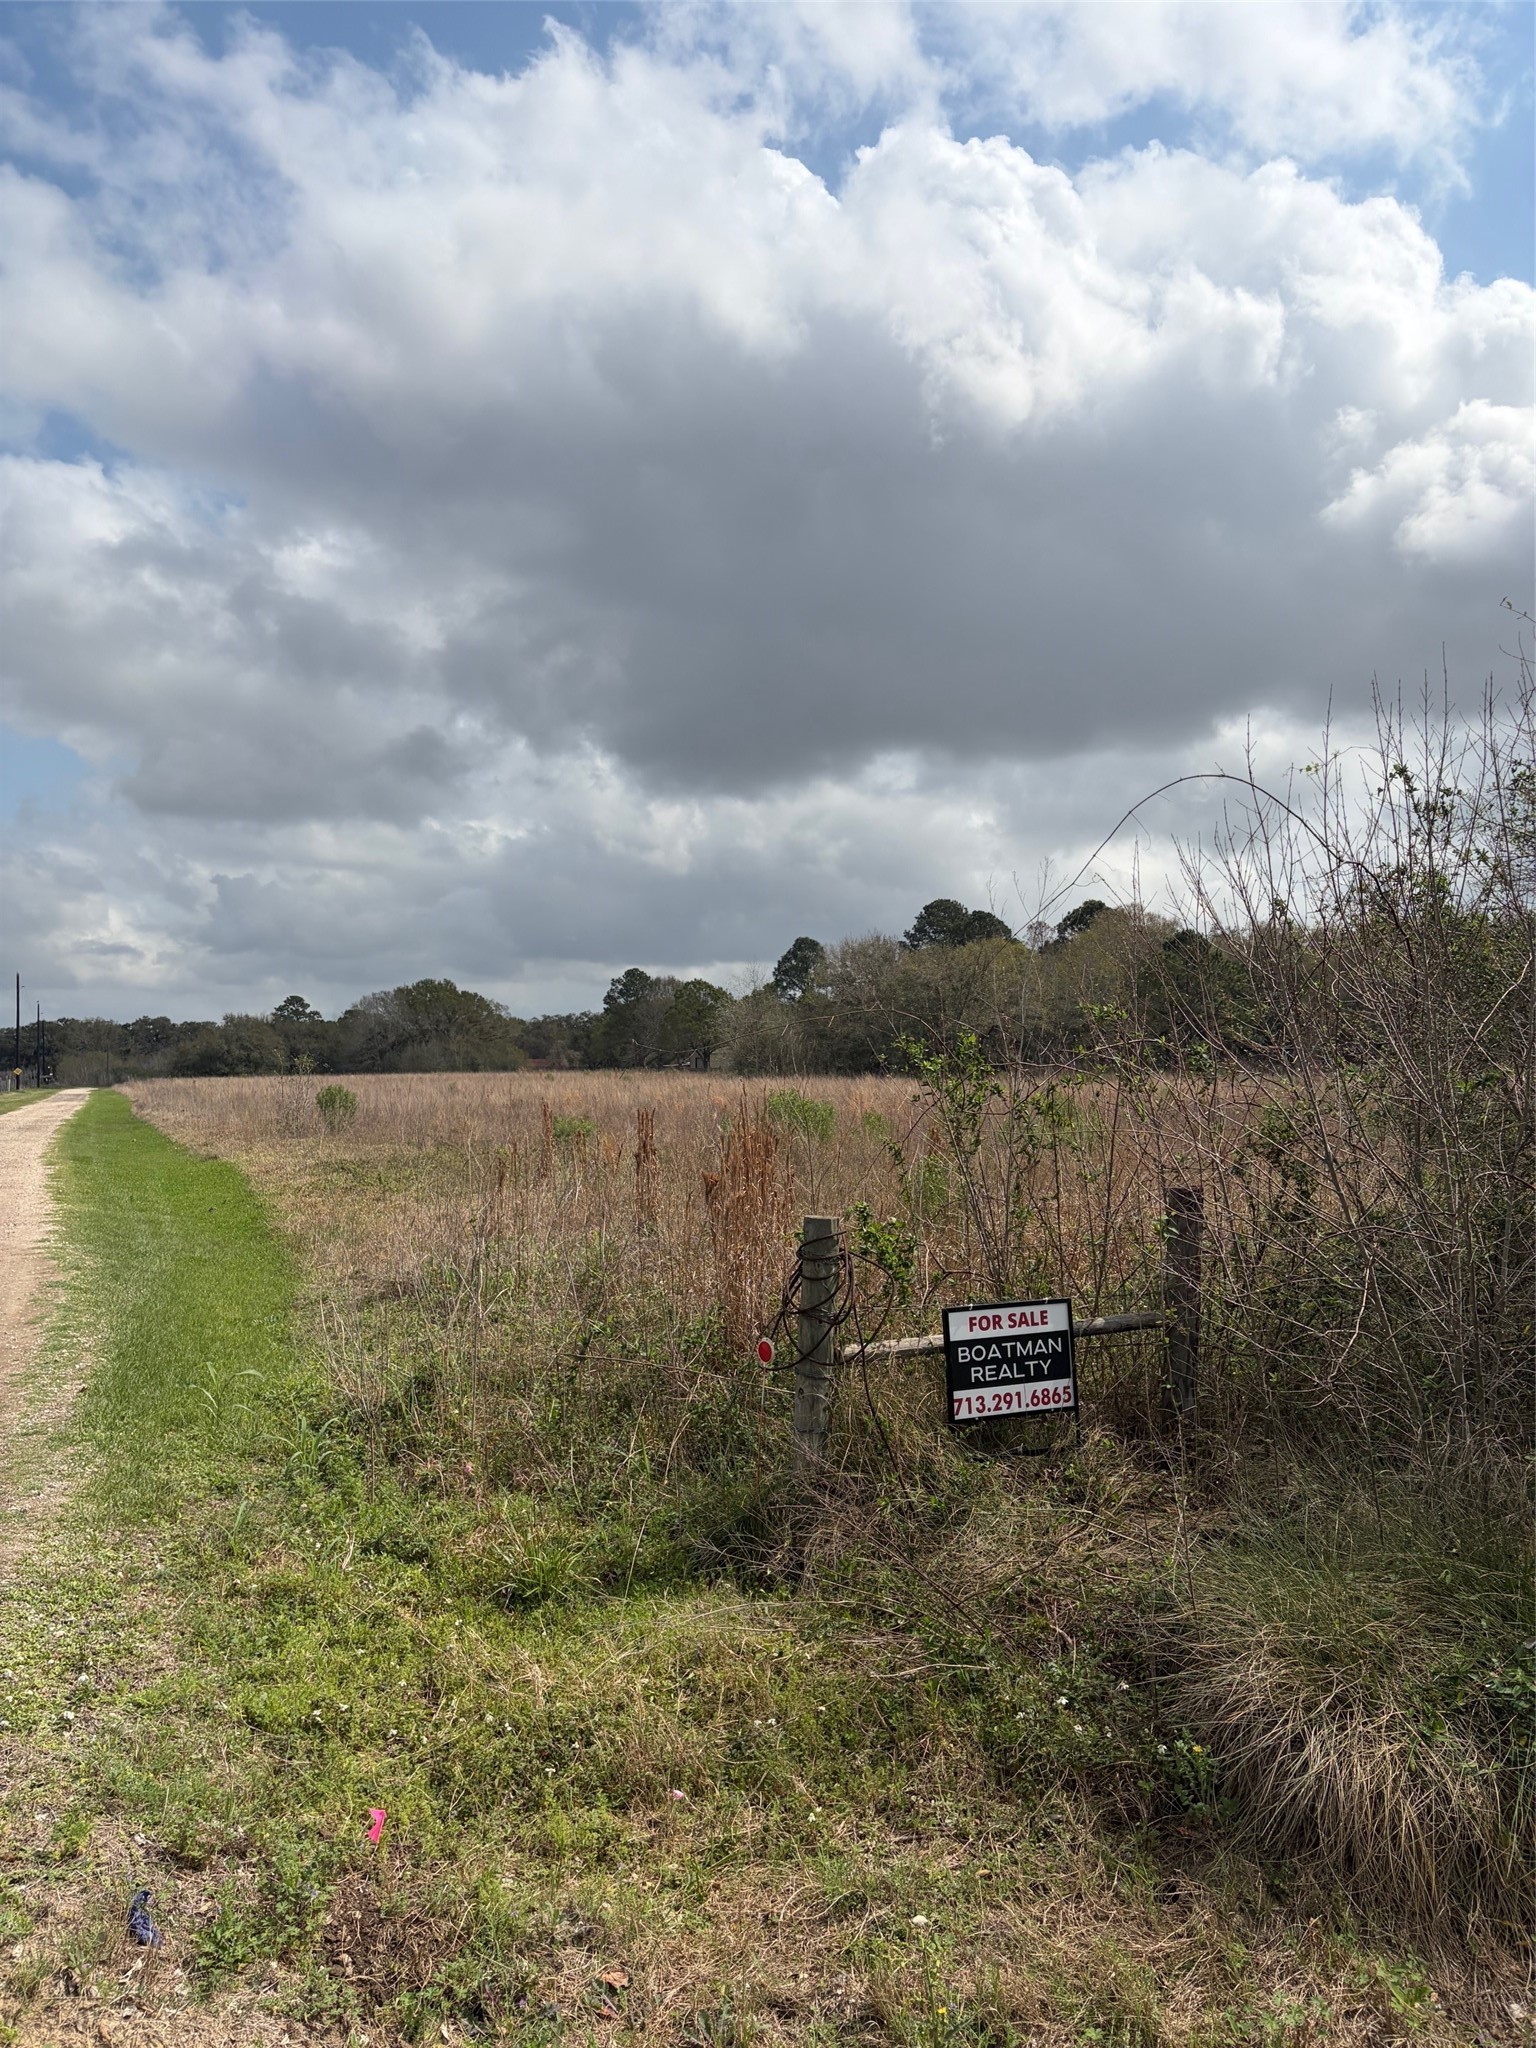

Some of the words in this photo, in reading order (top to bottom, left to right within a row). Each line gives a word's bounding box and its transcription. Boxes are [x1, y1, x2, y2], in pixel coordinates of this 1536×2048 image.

[968, 1314, 1003, 1332] FOR
[1007, 1310, 1049, 1328] SALE
[957, 1337, 1062, 1363] BOATMAN
[970, 1359, 1052, 1383] REALTY
[953, 1385, 1072, 1417] 713.291.6865
